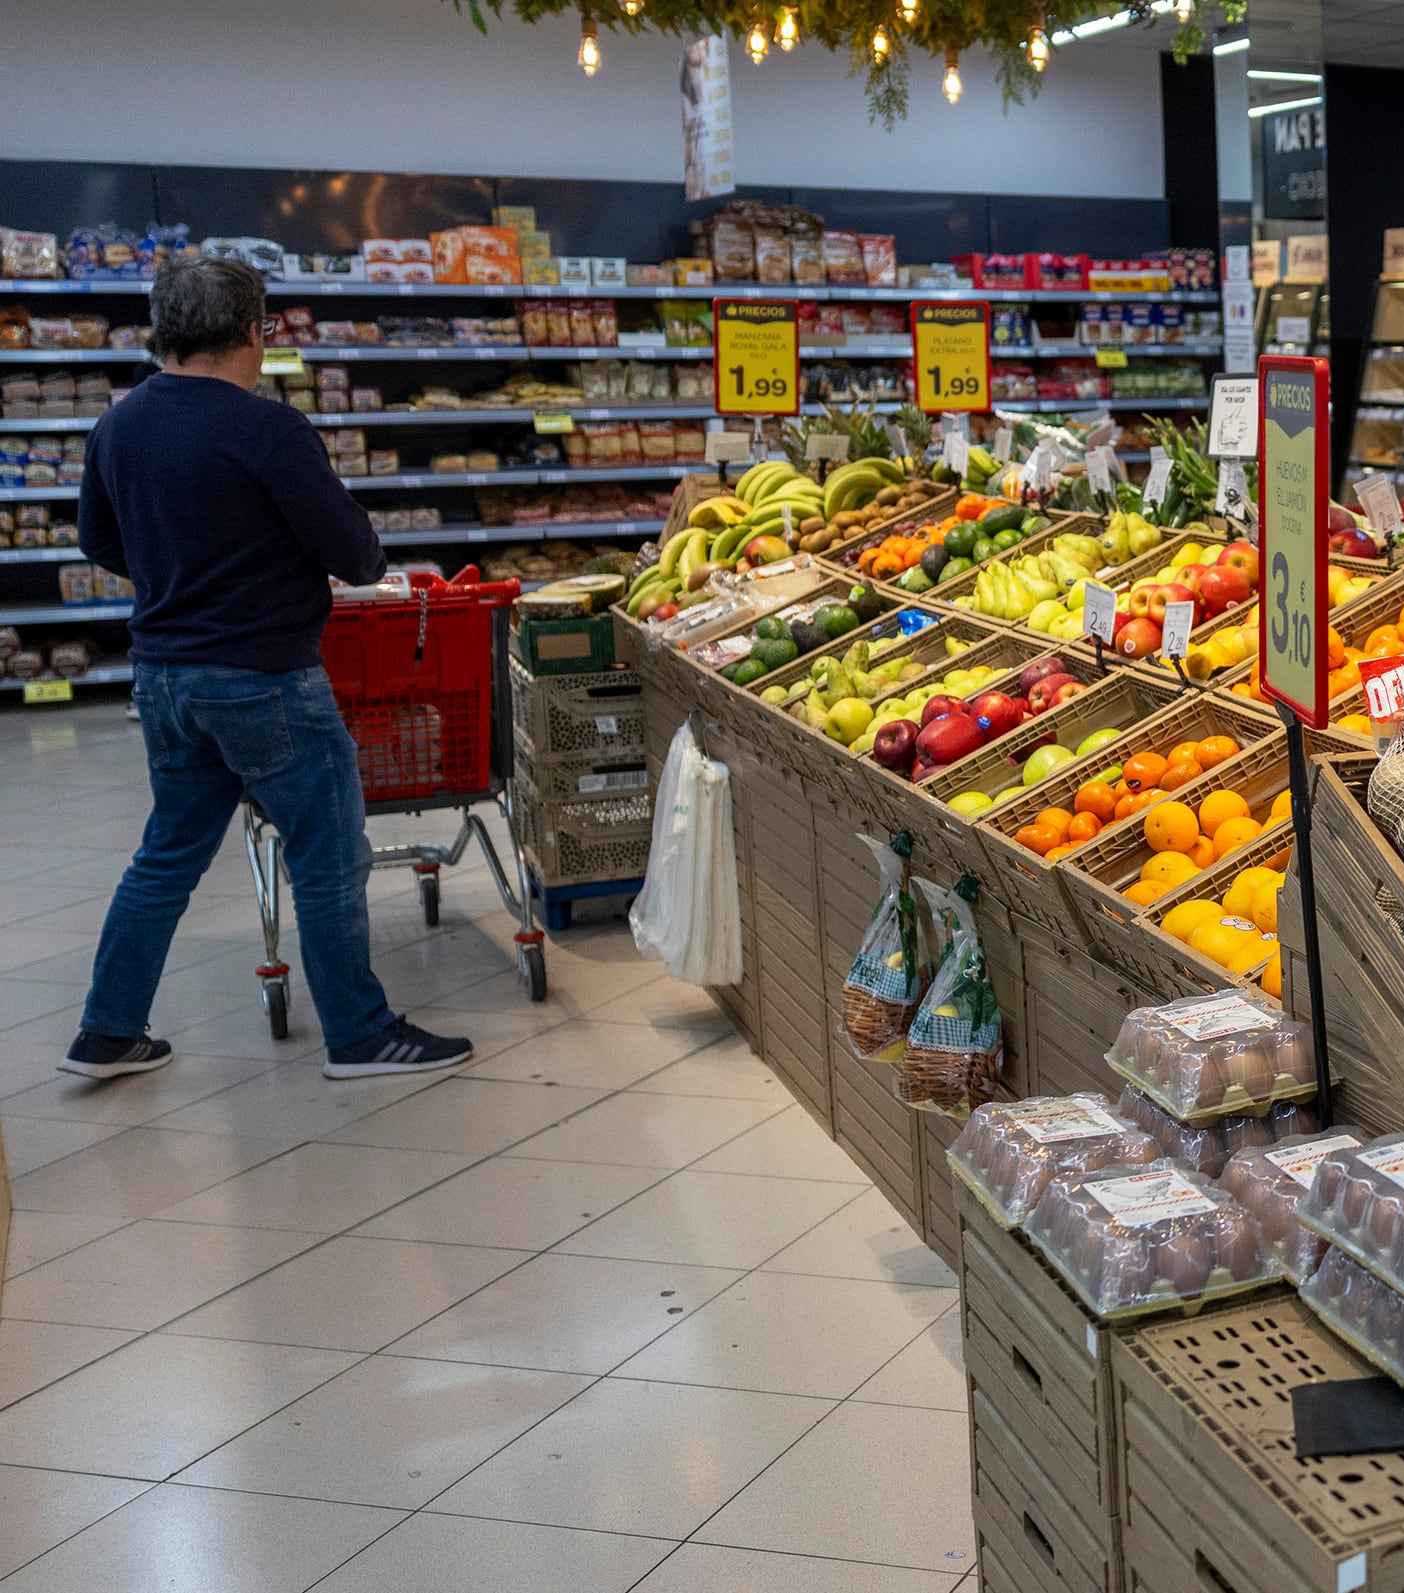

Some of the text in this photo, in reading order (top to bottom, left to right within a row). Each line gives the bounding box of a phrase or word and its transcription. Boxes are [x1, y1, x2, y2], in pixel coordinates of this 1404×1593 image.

[738, 305, 786, 318] PRECIOS
[934, 308, 977, 319] PRECIOS
[728, 364, 787, 399] 1,99
[926, 365, 979, 398] 1,99
[1277, 384, 1312, 412] PRECIOS
[1276, 461, 1302, 483] HUEVOS
[1271, 551, 1311, 668] 3,10 €
